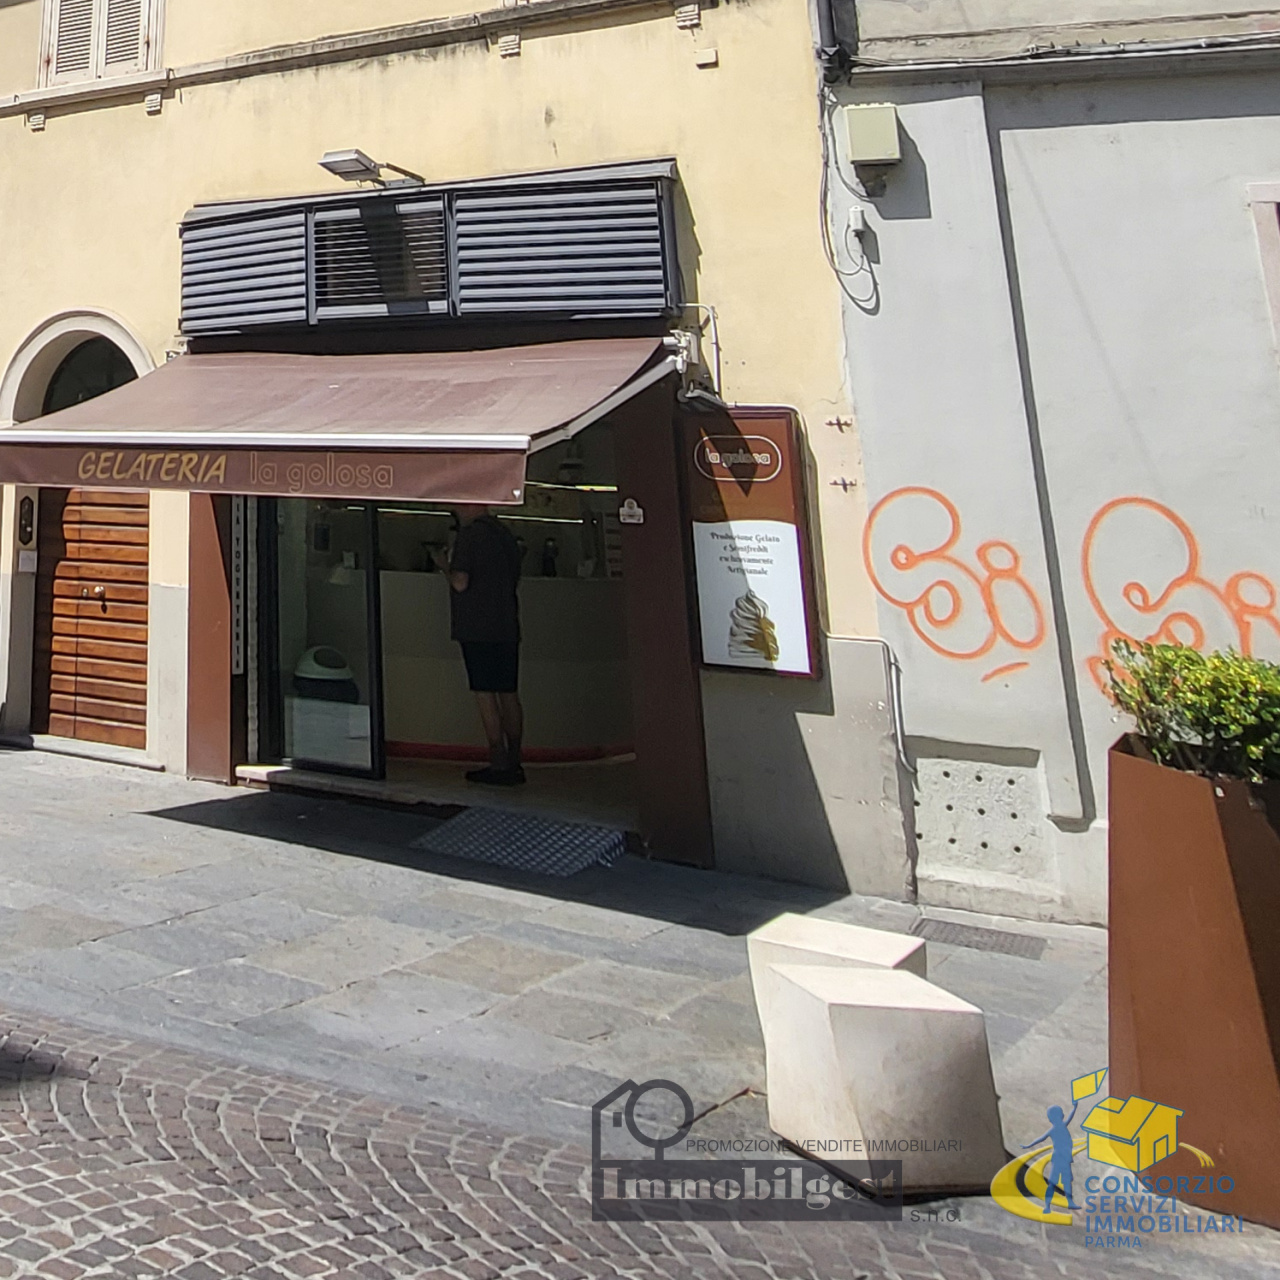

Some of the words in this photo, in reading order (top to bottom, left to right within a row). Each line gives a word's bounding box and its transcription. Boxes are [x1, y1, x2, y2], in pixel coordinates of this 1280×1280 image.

[705, 447, 720, 464] la
[78, 451, 228, 484] GELATERIA
[250, 451, 278, 485] la
[286, 452, 395, 494] golosa
[755, 533, 782, 544] Gelato
